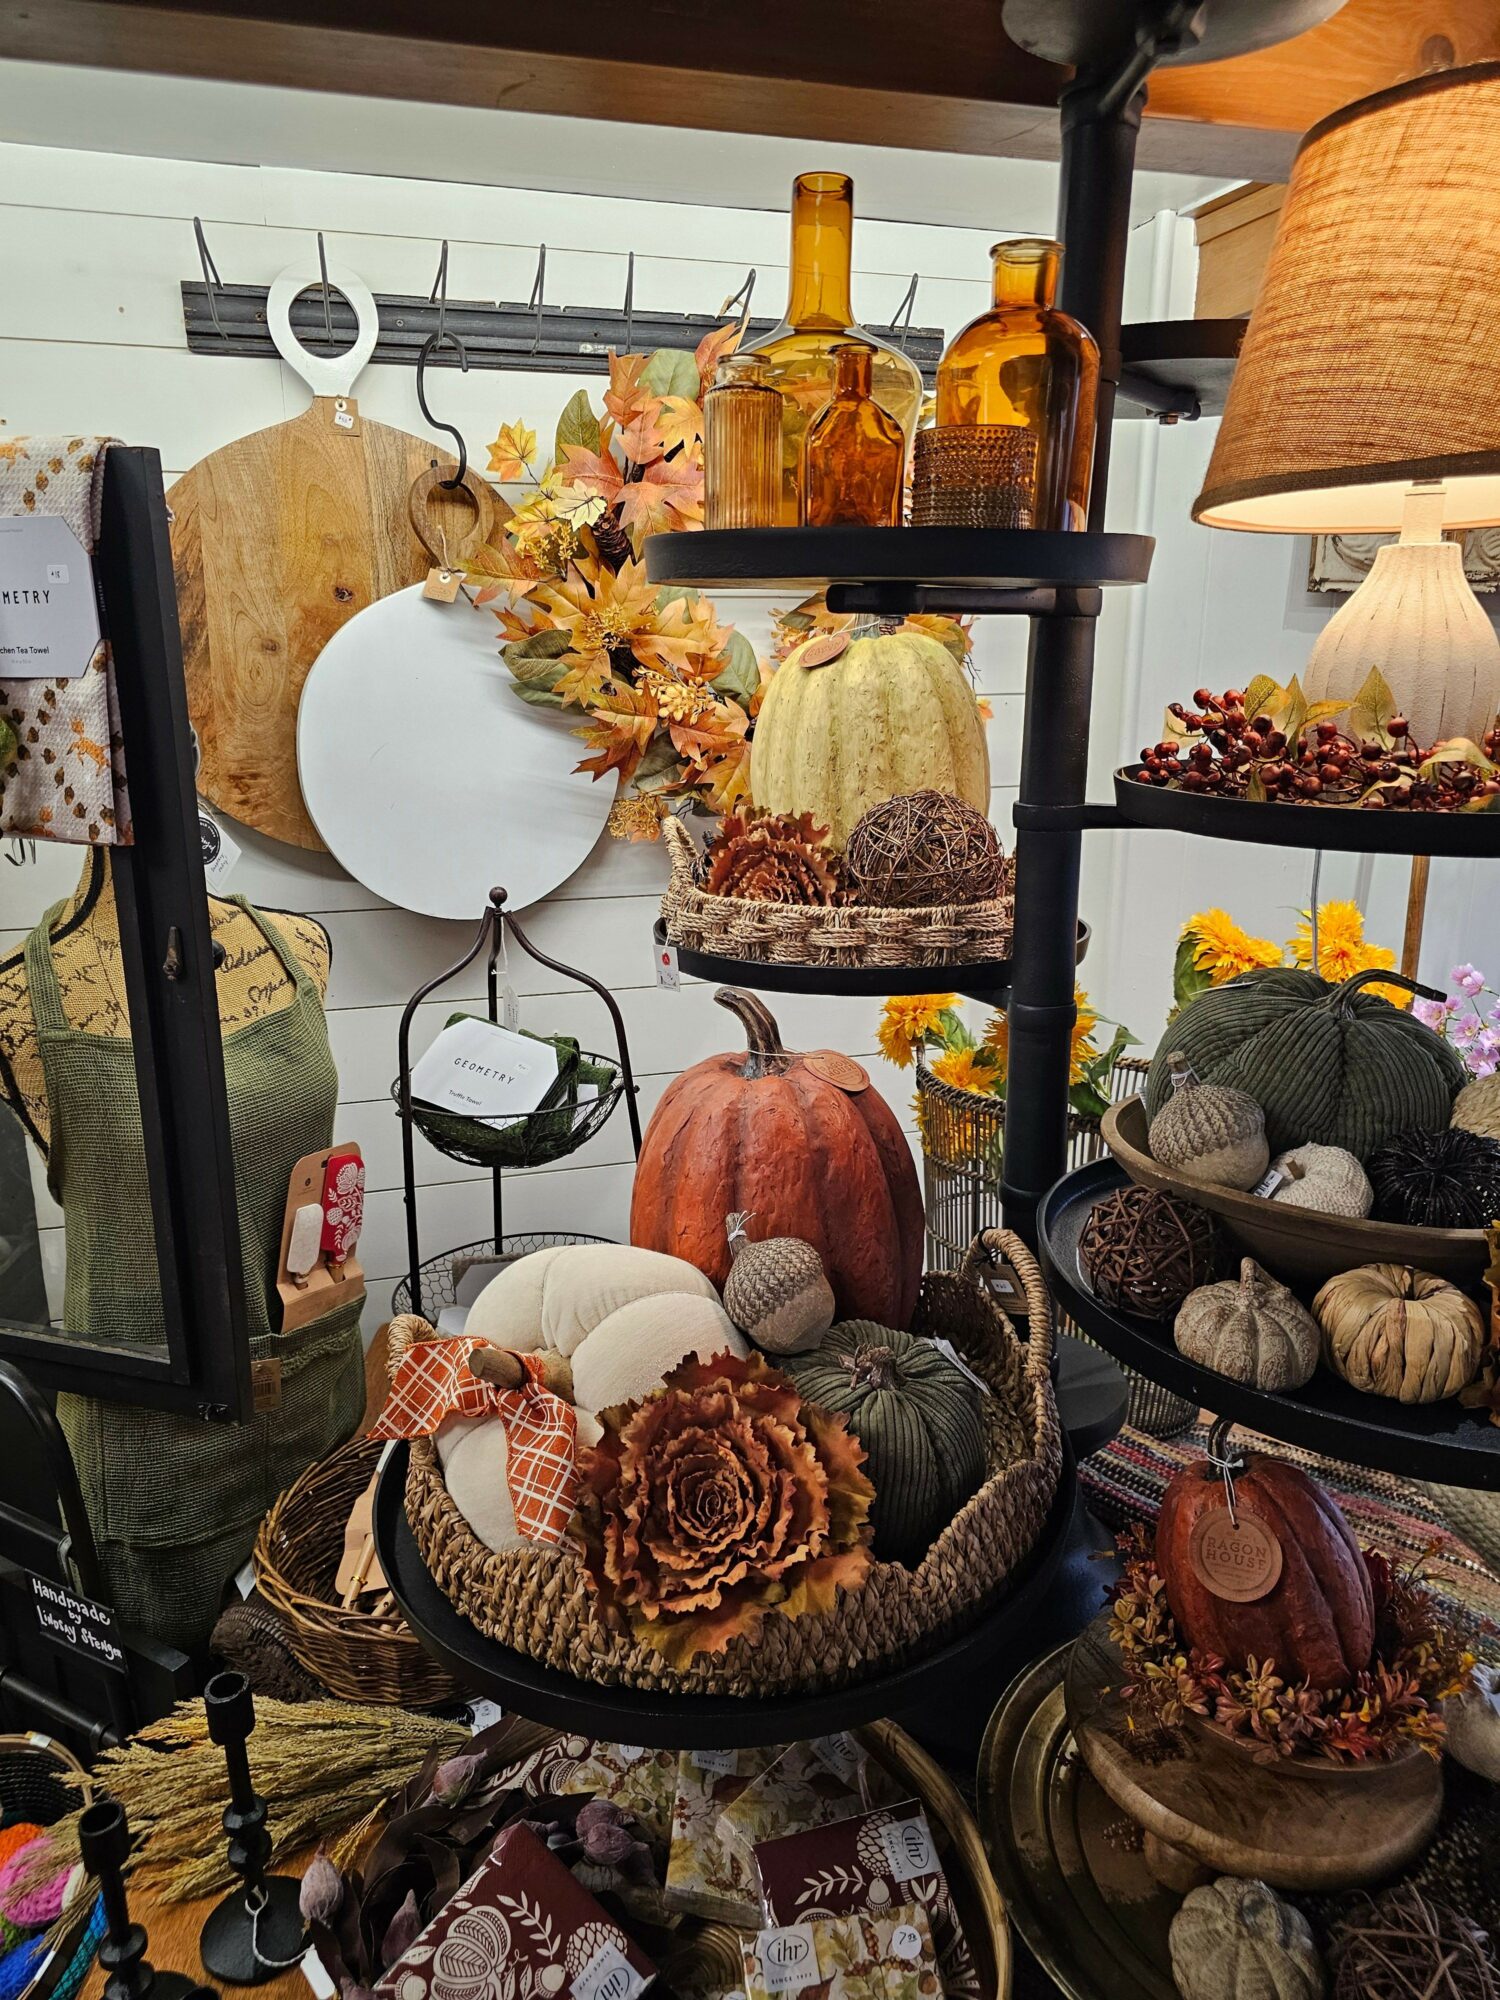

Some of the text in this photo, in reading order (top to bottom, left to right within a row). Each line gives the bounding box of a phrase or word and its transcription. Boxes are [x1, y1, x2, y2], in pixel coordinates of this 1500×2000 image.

[2, 590, 50, 605] METRY
[16, 646, 29, 654] Tea
[29, 646, 49, 654] Towel
[454, 1057, 515, 1085] GEOMETRY
[466, 1096, 482, 1106] Towel
[1207, 1536, 1266, 1559] RAGON
[1205, 1548, 1266, 1571] HOUSE
[32, 1578, 111, 1626] Handmade
[67, 1609, 82, 1625] by
[904, 1836, 924, 1862] ihr
[777, 1939, 803, 1963] ihr
